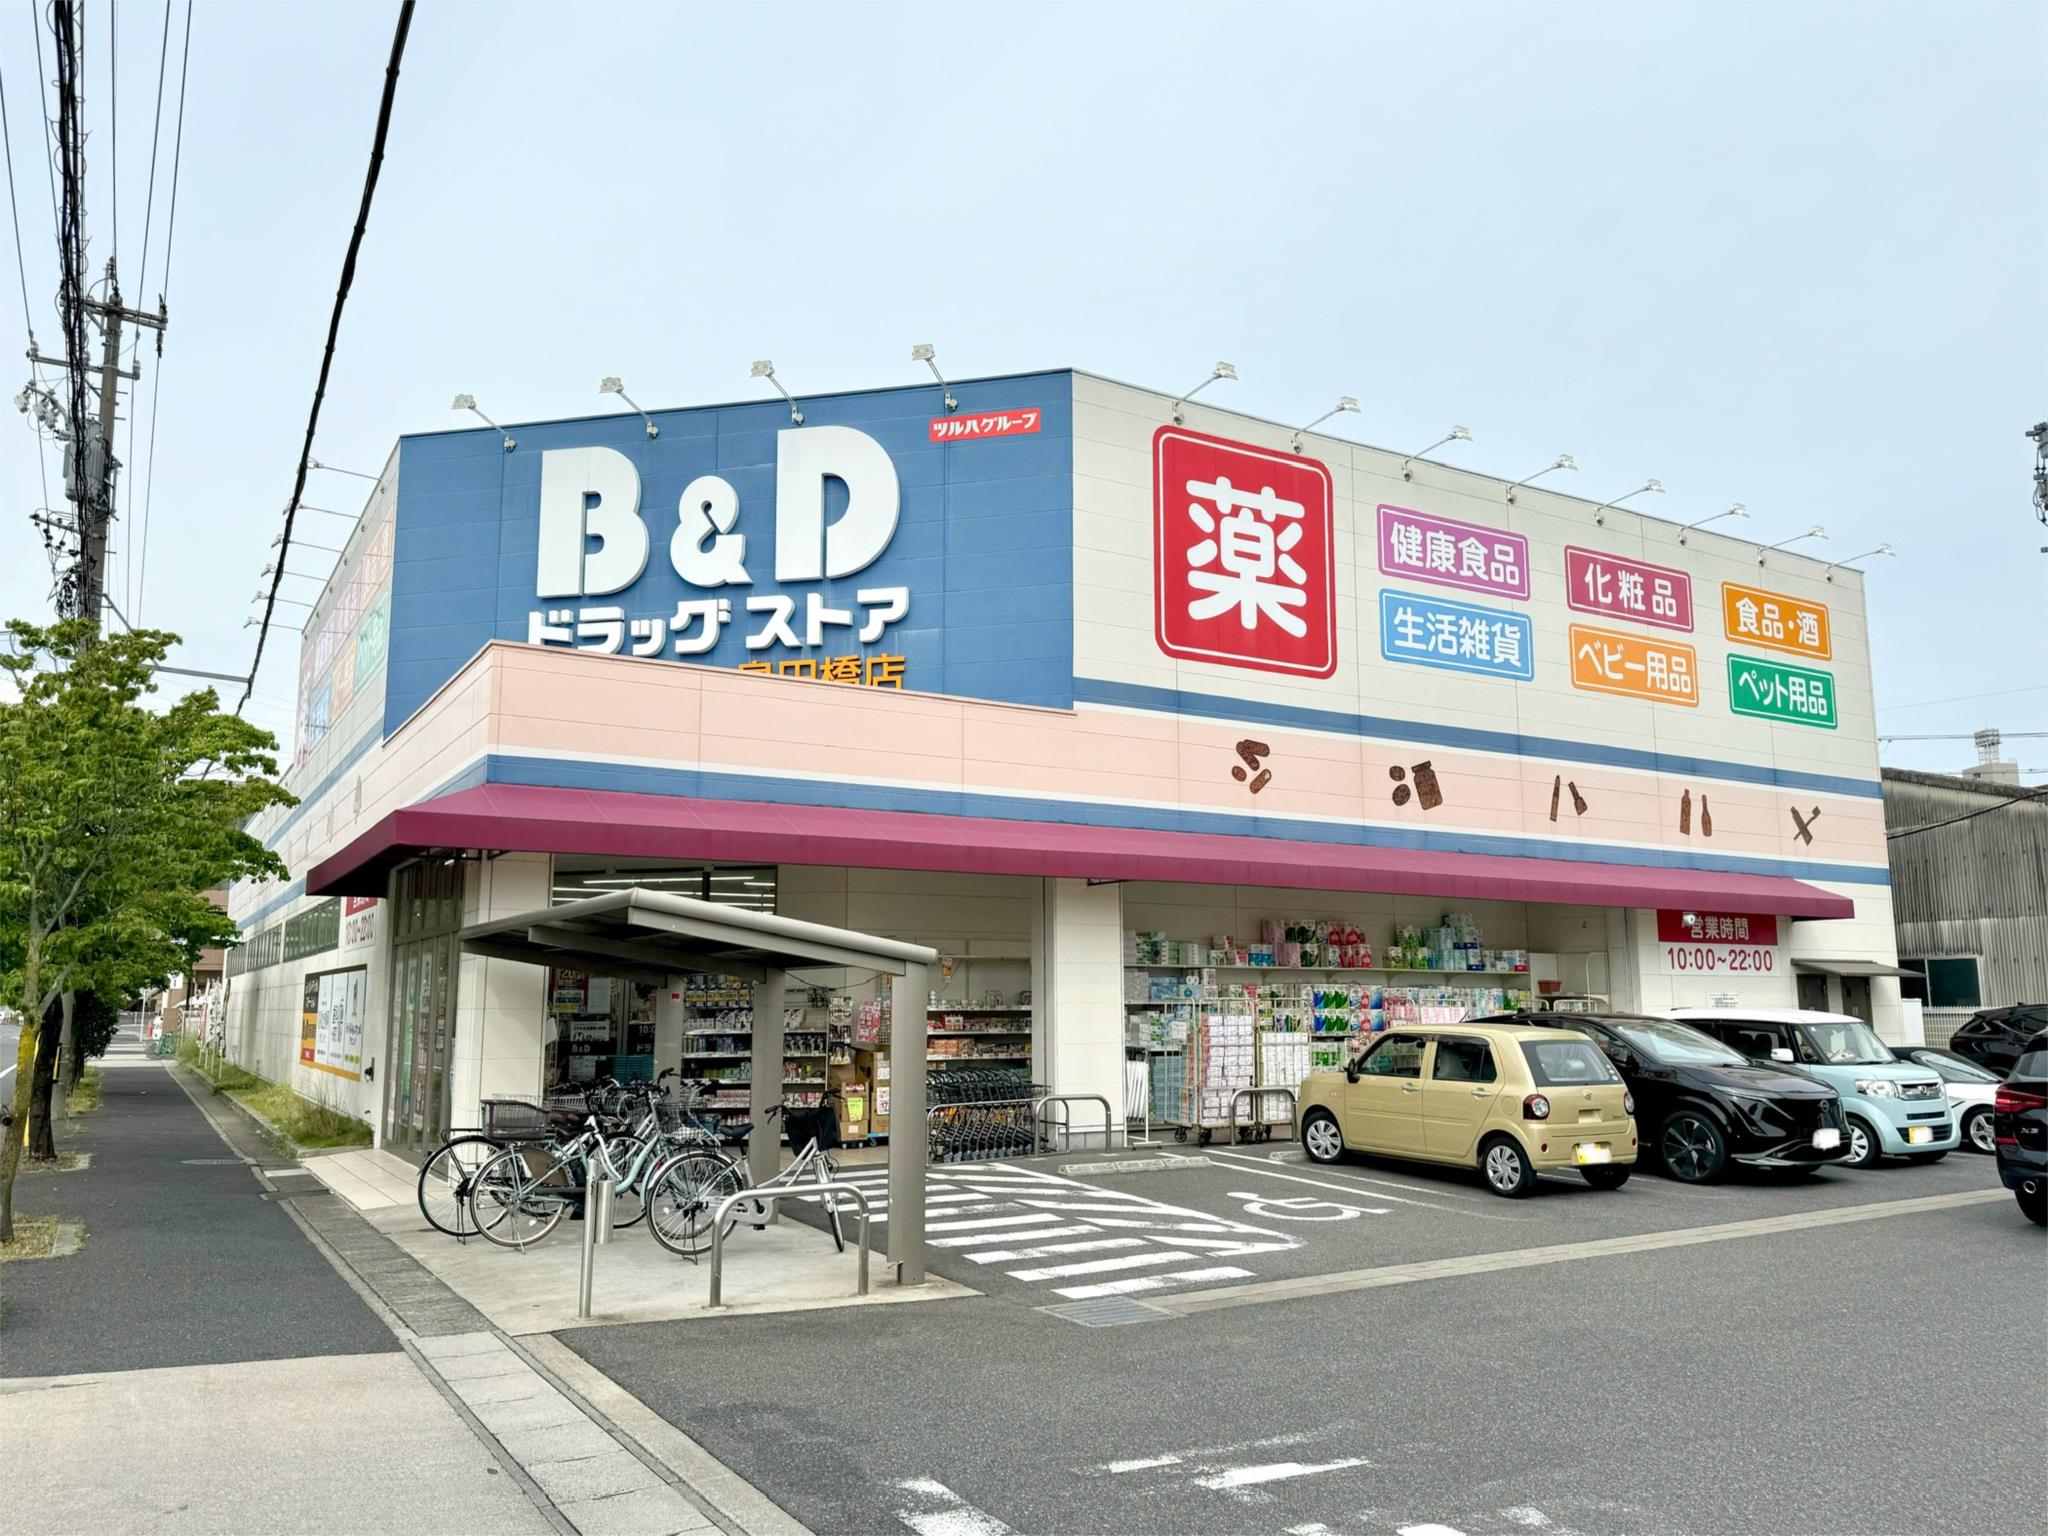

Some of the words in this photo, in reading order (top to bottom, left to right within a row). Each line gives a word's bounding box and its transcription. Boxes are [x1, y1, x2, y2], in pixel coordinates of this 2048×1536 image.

[933, 412, 1038, 438] ツルハグループ
[536, 425, 901, 599] B&D
[1186, 476, 1308, 638] 薬
[1390, 521, 1520, 586] 健康食品
[1584, 563, 1677, 618] 化粧品
[1393, 606, 1522, 667] 生活雑貨
[1578, 640, 1691, 694] ベビー用品
[1738, 669, 1828, 715] ペット用品
